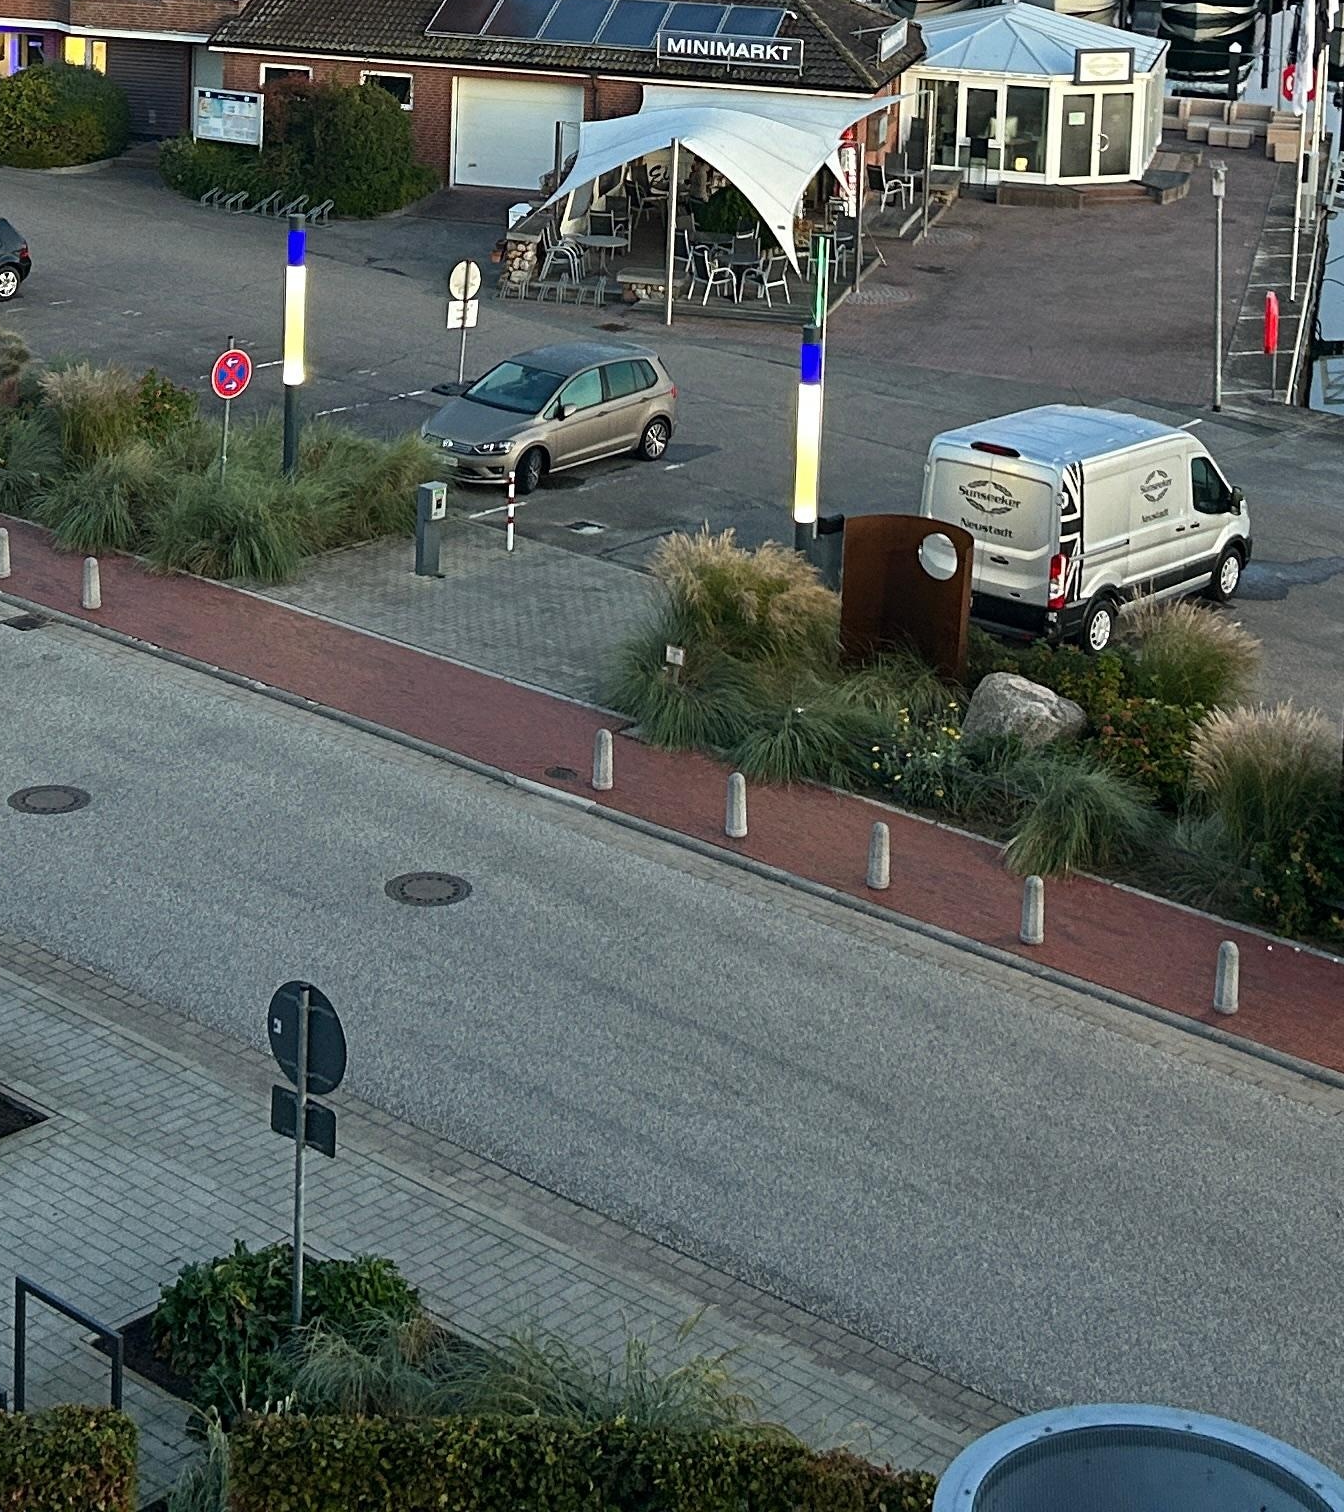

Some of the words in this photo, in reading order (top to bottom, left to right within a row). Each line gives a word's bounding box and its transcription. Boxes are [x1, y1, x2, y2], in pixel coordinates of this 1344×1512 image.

[667, 38, 793, 61] MINIMARKT
[958, 484, 1022, 509] Sunseeker
[960, 516, 1014, 539] Neustadt
